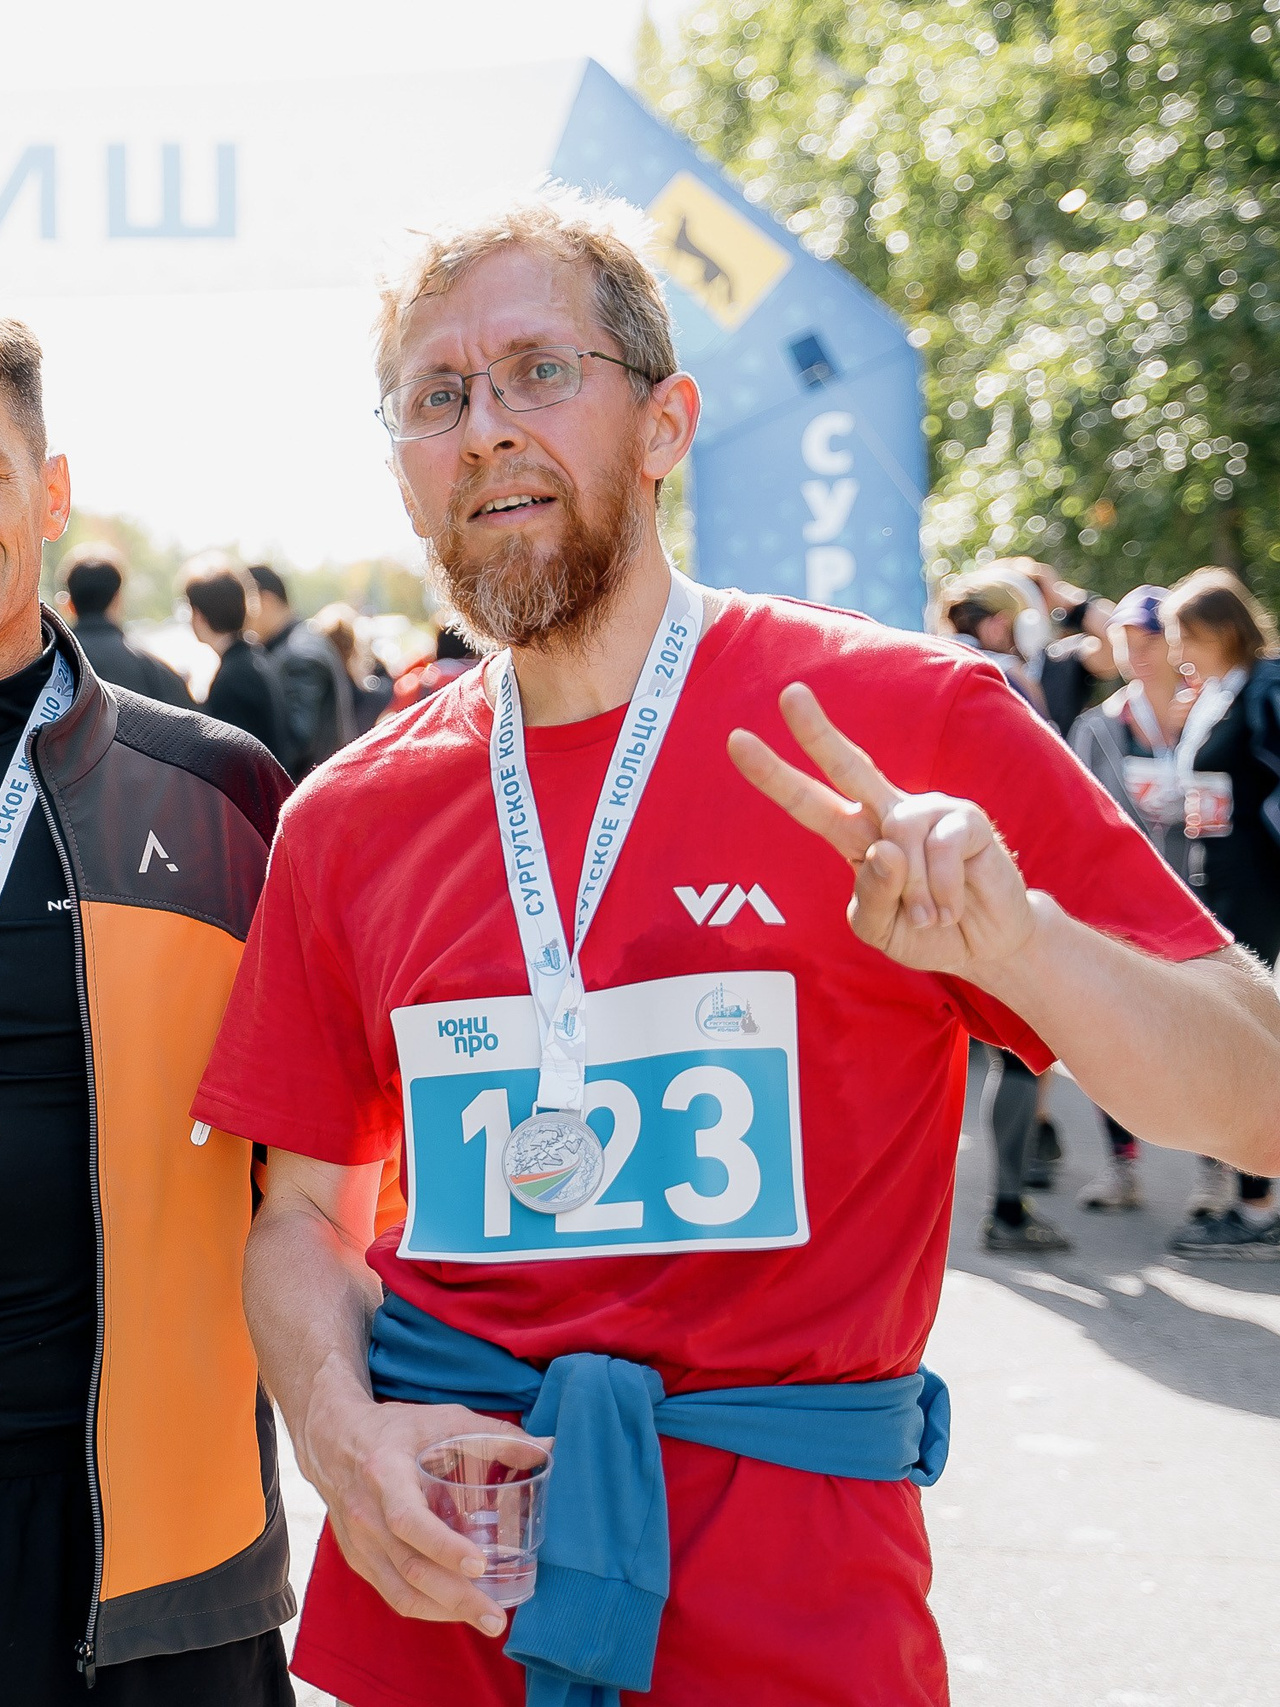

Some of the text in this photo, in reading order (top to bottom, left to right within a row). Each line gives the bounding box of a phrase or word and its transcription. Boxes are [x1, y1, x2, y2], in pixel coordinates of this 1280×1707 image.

[499, 672, 544, 916] СУРГУТСКОЕ КОЛЬЦО
[609, 707, 659, 806] КОЛЬЦО
[654, 622, 688, 678] 2025
[461, 1066, 761, 1237] 123
